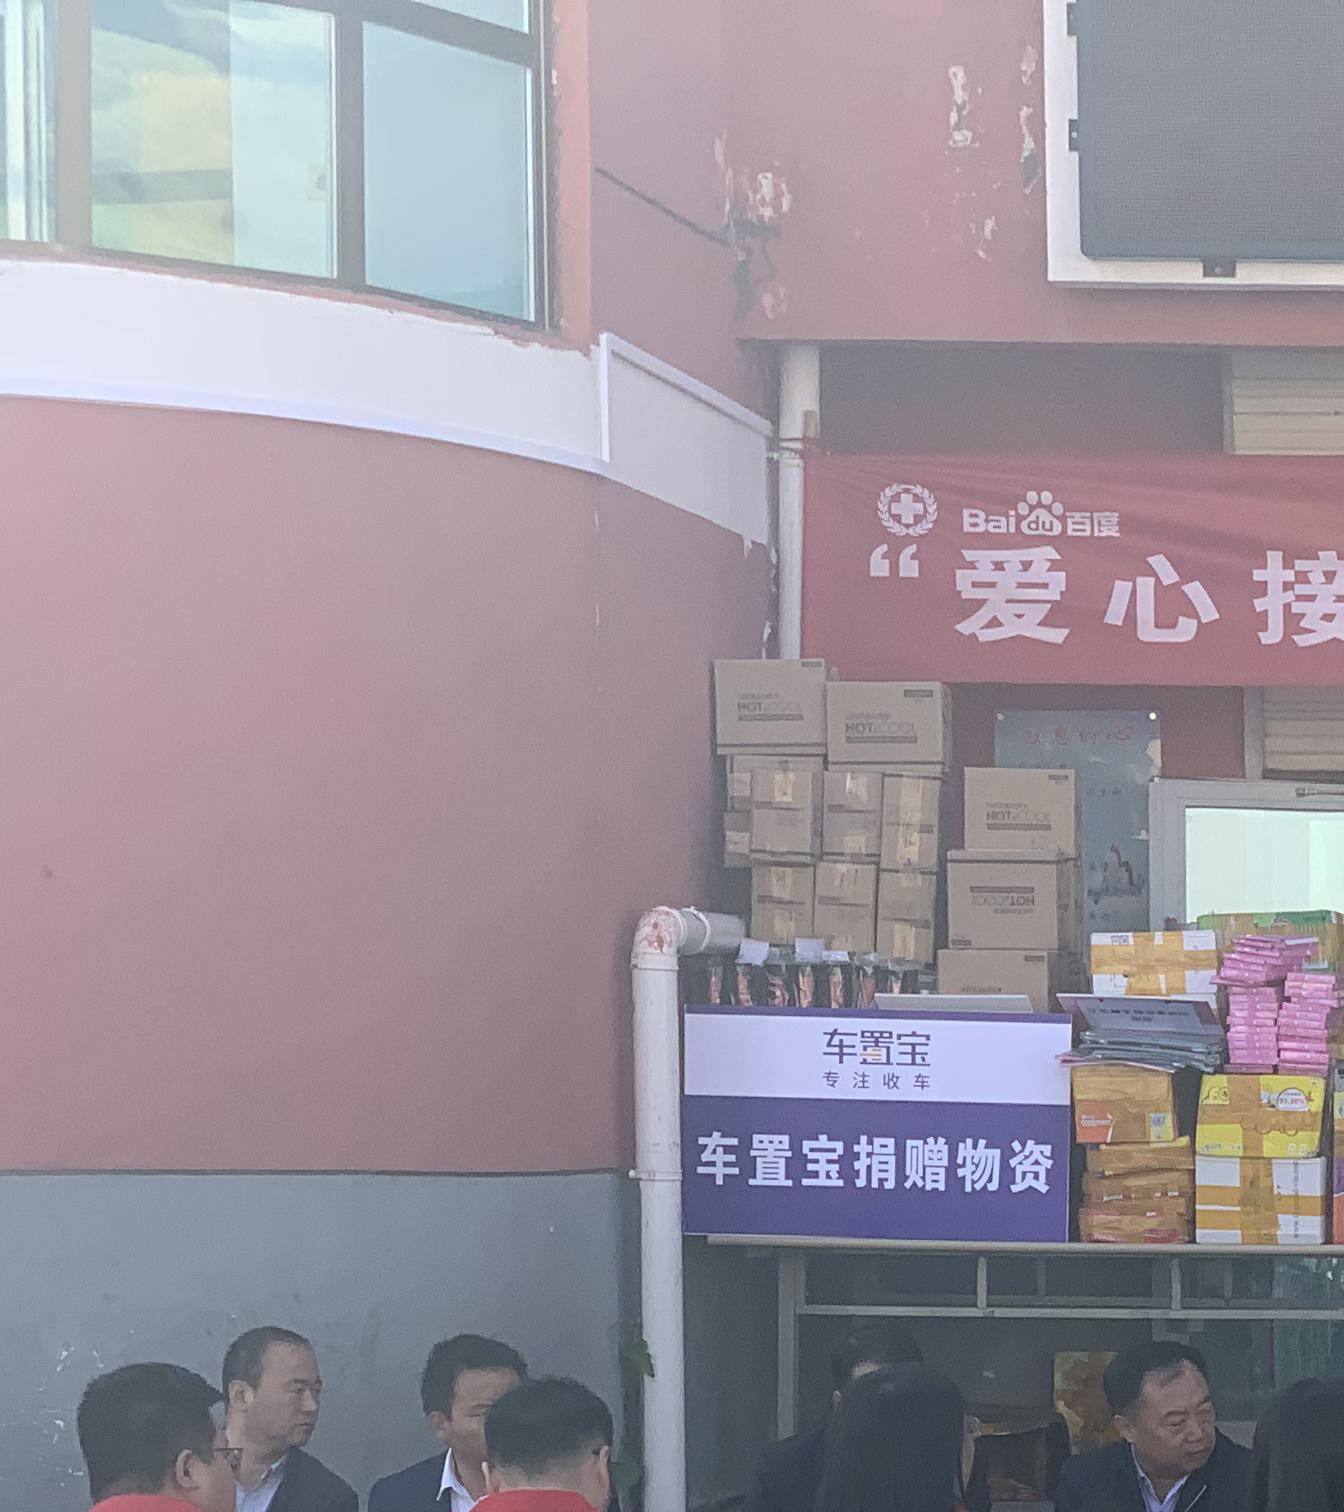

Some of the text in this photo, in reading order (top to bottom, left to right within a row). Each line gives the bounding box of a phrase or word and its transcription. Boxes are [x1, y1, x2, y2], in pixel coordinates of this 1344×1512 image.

[1065, 511, 1121, 537] 百度
[822, 1028, 932, 1068] 车置宝
[822, 1070, 932, 1092] 专注收车
[696, 1131, 1055, 1195] 车置宝捐赠物资
